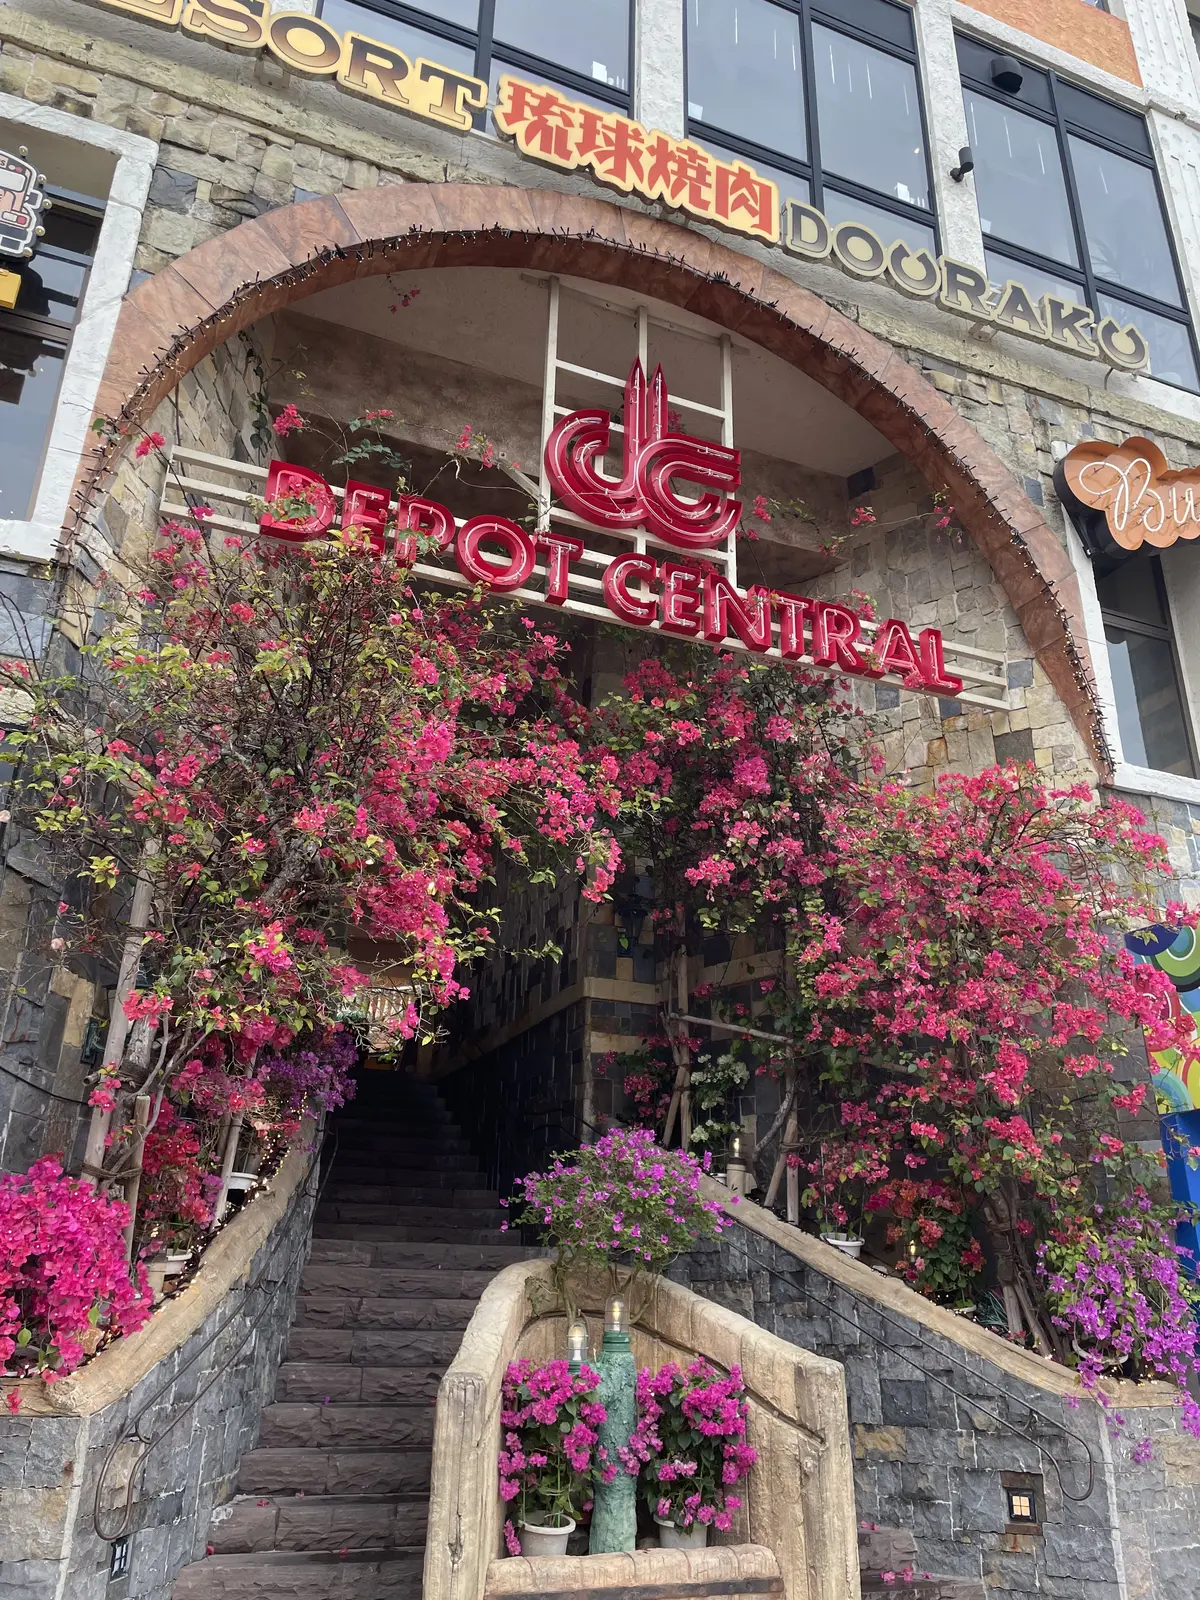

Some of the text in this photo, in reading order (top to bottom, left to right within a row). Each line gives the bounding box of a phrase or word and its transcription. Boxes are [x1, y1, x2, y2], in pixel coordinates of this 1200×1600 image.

[116, 0, 482, 126] SORT
[502, 81, 773, 236] 琉球焼肉
[260, 459, 964, 695] DEPOT CENTRAL
